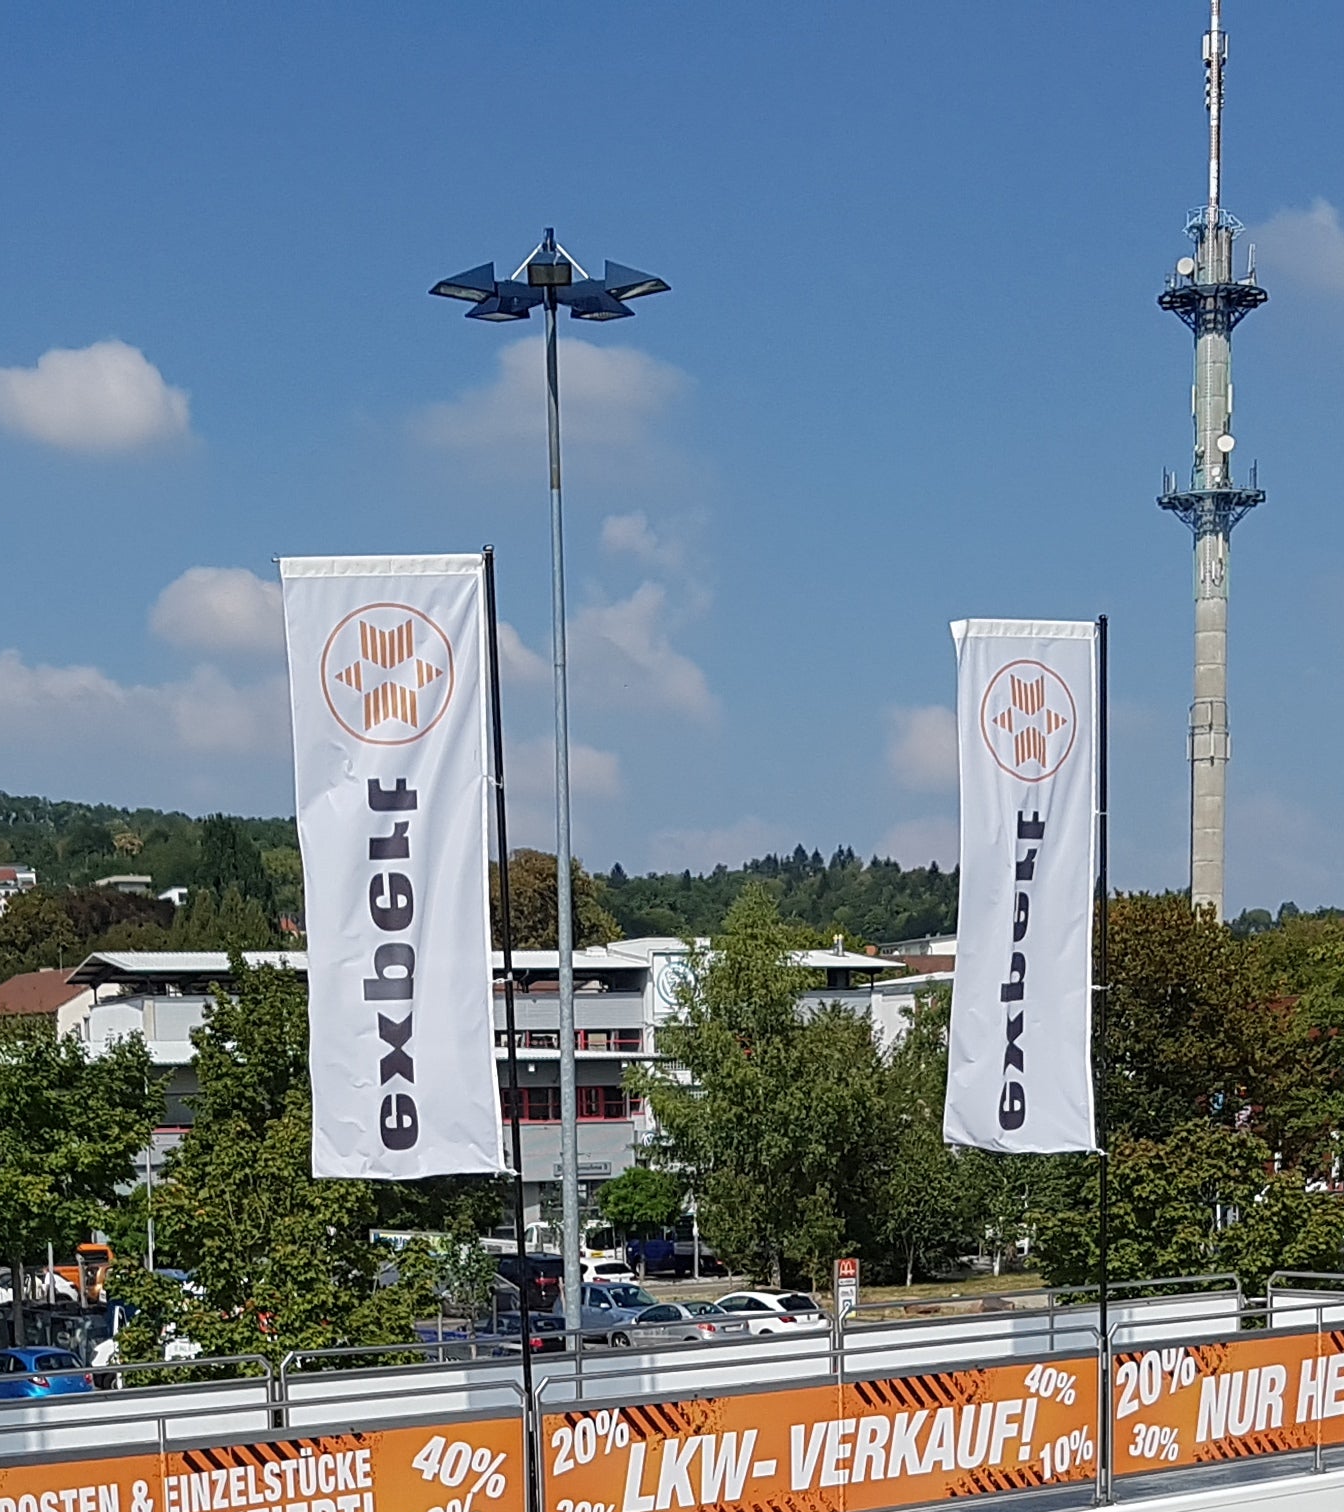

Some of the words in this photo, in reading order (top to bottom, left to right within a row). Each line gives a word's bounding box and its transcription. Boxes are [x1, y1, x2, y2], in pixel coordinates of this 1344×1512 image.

[362, 775, 419, 1150] expert
[998, 809, 1046, 1131] expert
[1023, 1364, 1077, 1406] 40%
[1116, 1346, 1196, 1420] 20%
[1195, 1364, 1287, 1443] NUR
[411, 1434, 508, 1500] 40%
[551, 1408, 630, 1477] 20%
[789, 1397, 1039, 1491] VERKAUF!
[1039, 1424, 1094, 1481] 10%
[1128, 1421, 1180, 1461] 30%
